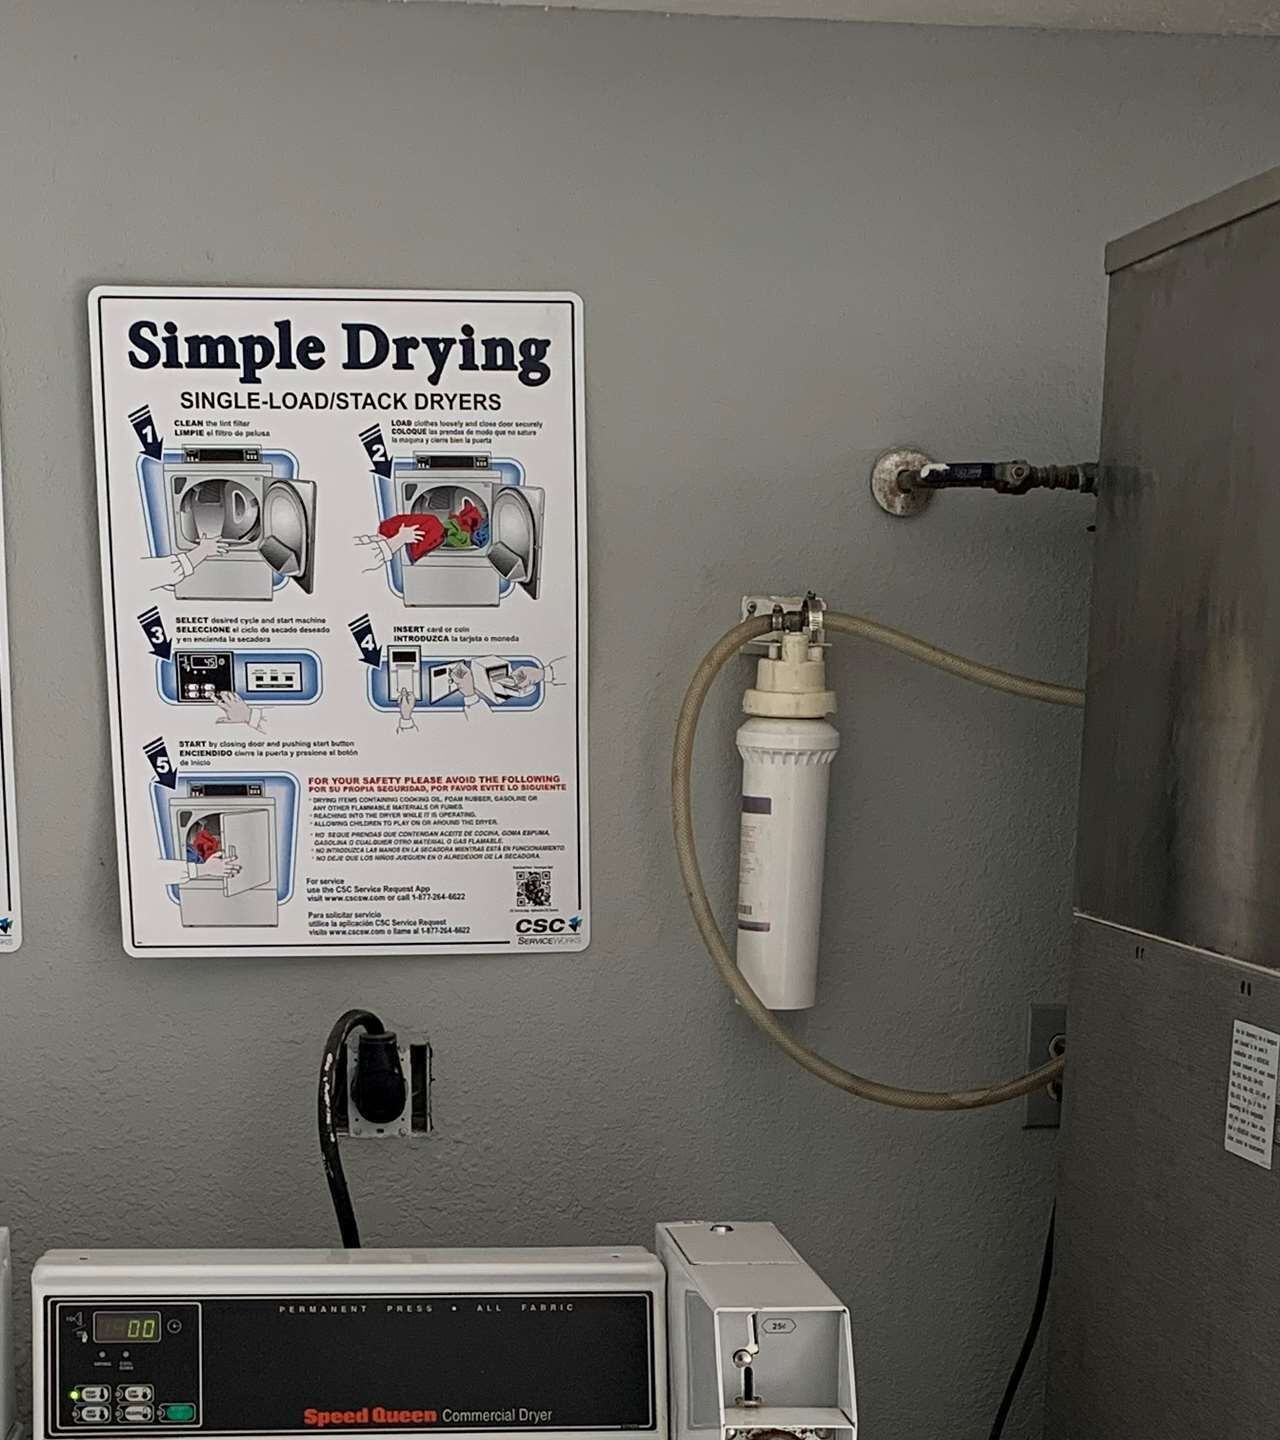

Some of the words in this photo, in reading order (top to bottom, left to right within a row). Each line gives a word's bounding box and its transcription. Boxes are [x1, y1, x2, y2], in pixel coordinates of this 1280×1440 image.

[128, 319, 326, 384] Simple
[341, 322, 552, 387] Drying
[181, 391, 408, 409] SINGLE-LOAD/STACK
[414, 393, 501, 410] DRYERS
[142, 425, 153, 443] 1
[371, 444, 385, 462] 2
[150, 626, 163, 644] 3
[360, 634, 375, 650] 4
[156, 757, 170, 773] 5
[515, 918, 566, 933] CSC
[387, 1304, 431, 1312] PRESS
[304, 1408, 369, 1427] Speed
[372, 1407, 437, 1423] Queen
[441, 1408, 515, 1423] Commercial
[519, 1408, 553, 1425] Dryer
